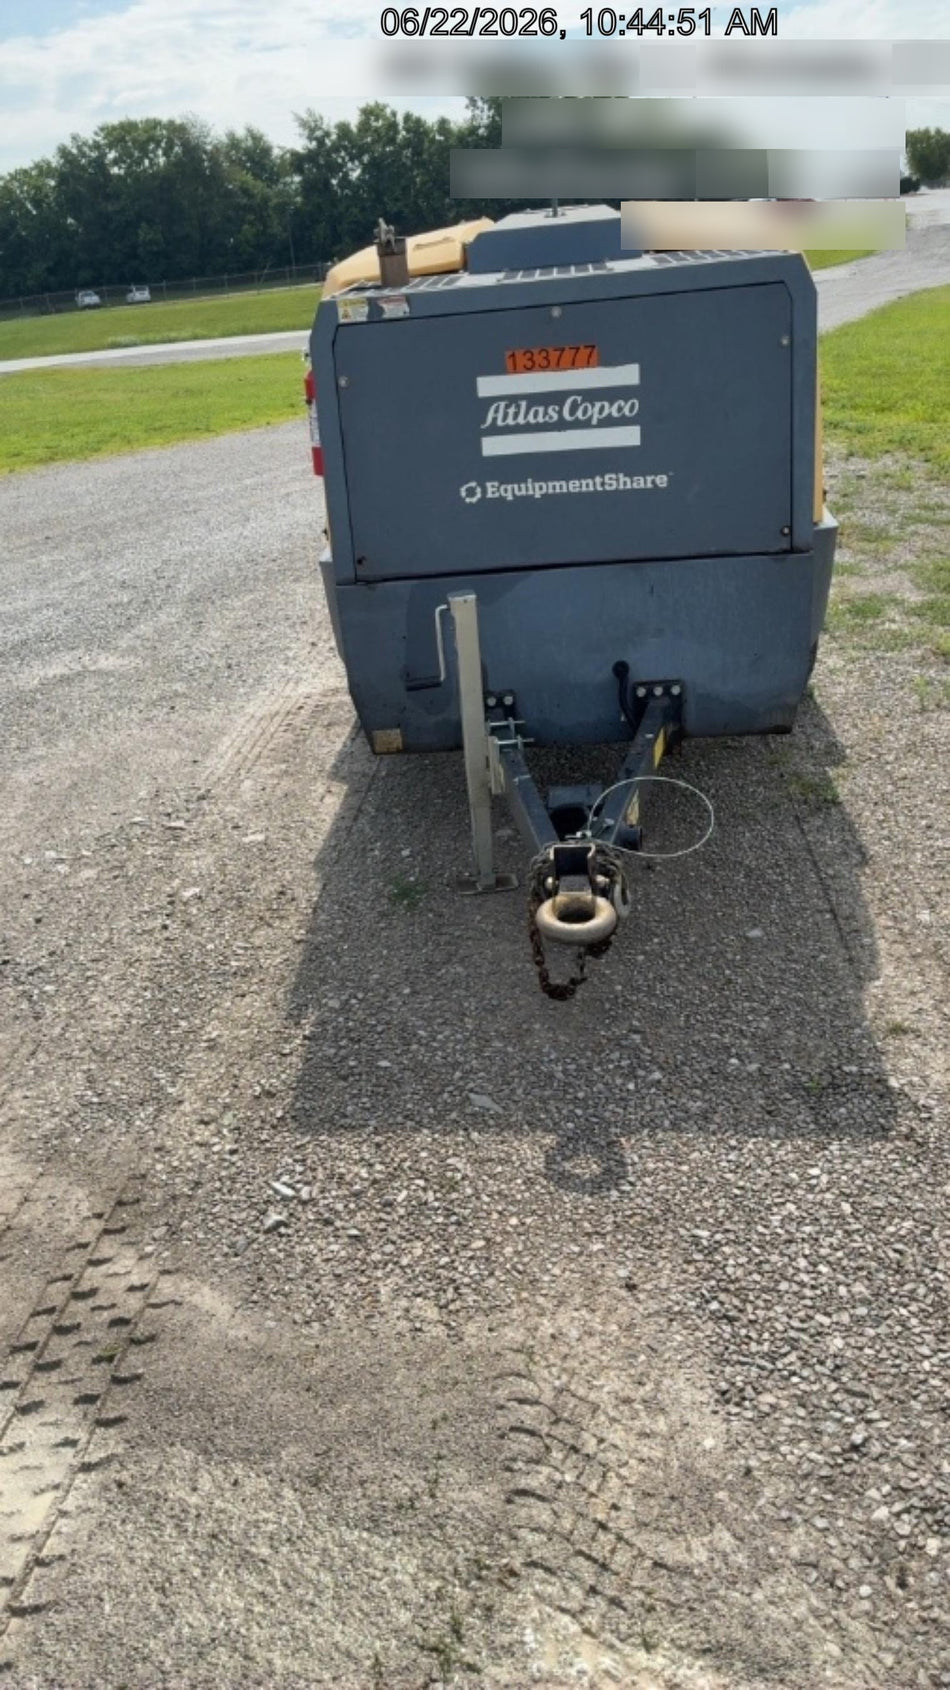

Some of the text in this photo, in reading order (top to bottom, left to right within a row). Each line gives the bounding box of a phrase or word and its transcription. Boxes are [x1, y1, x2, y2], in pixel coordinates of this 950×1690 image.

[507, 345, 597, 371] 133777
[480, 395, 640, 429] Atlas Copco
[485, 473, 668, 501] EquipmentShare
